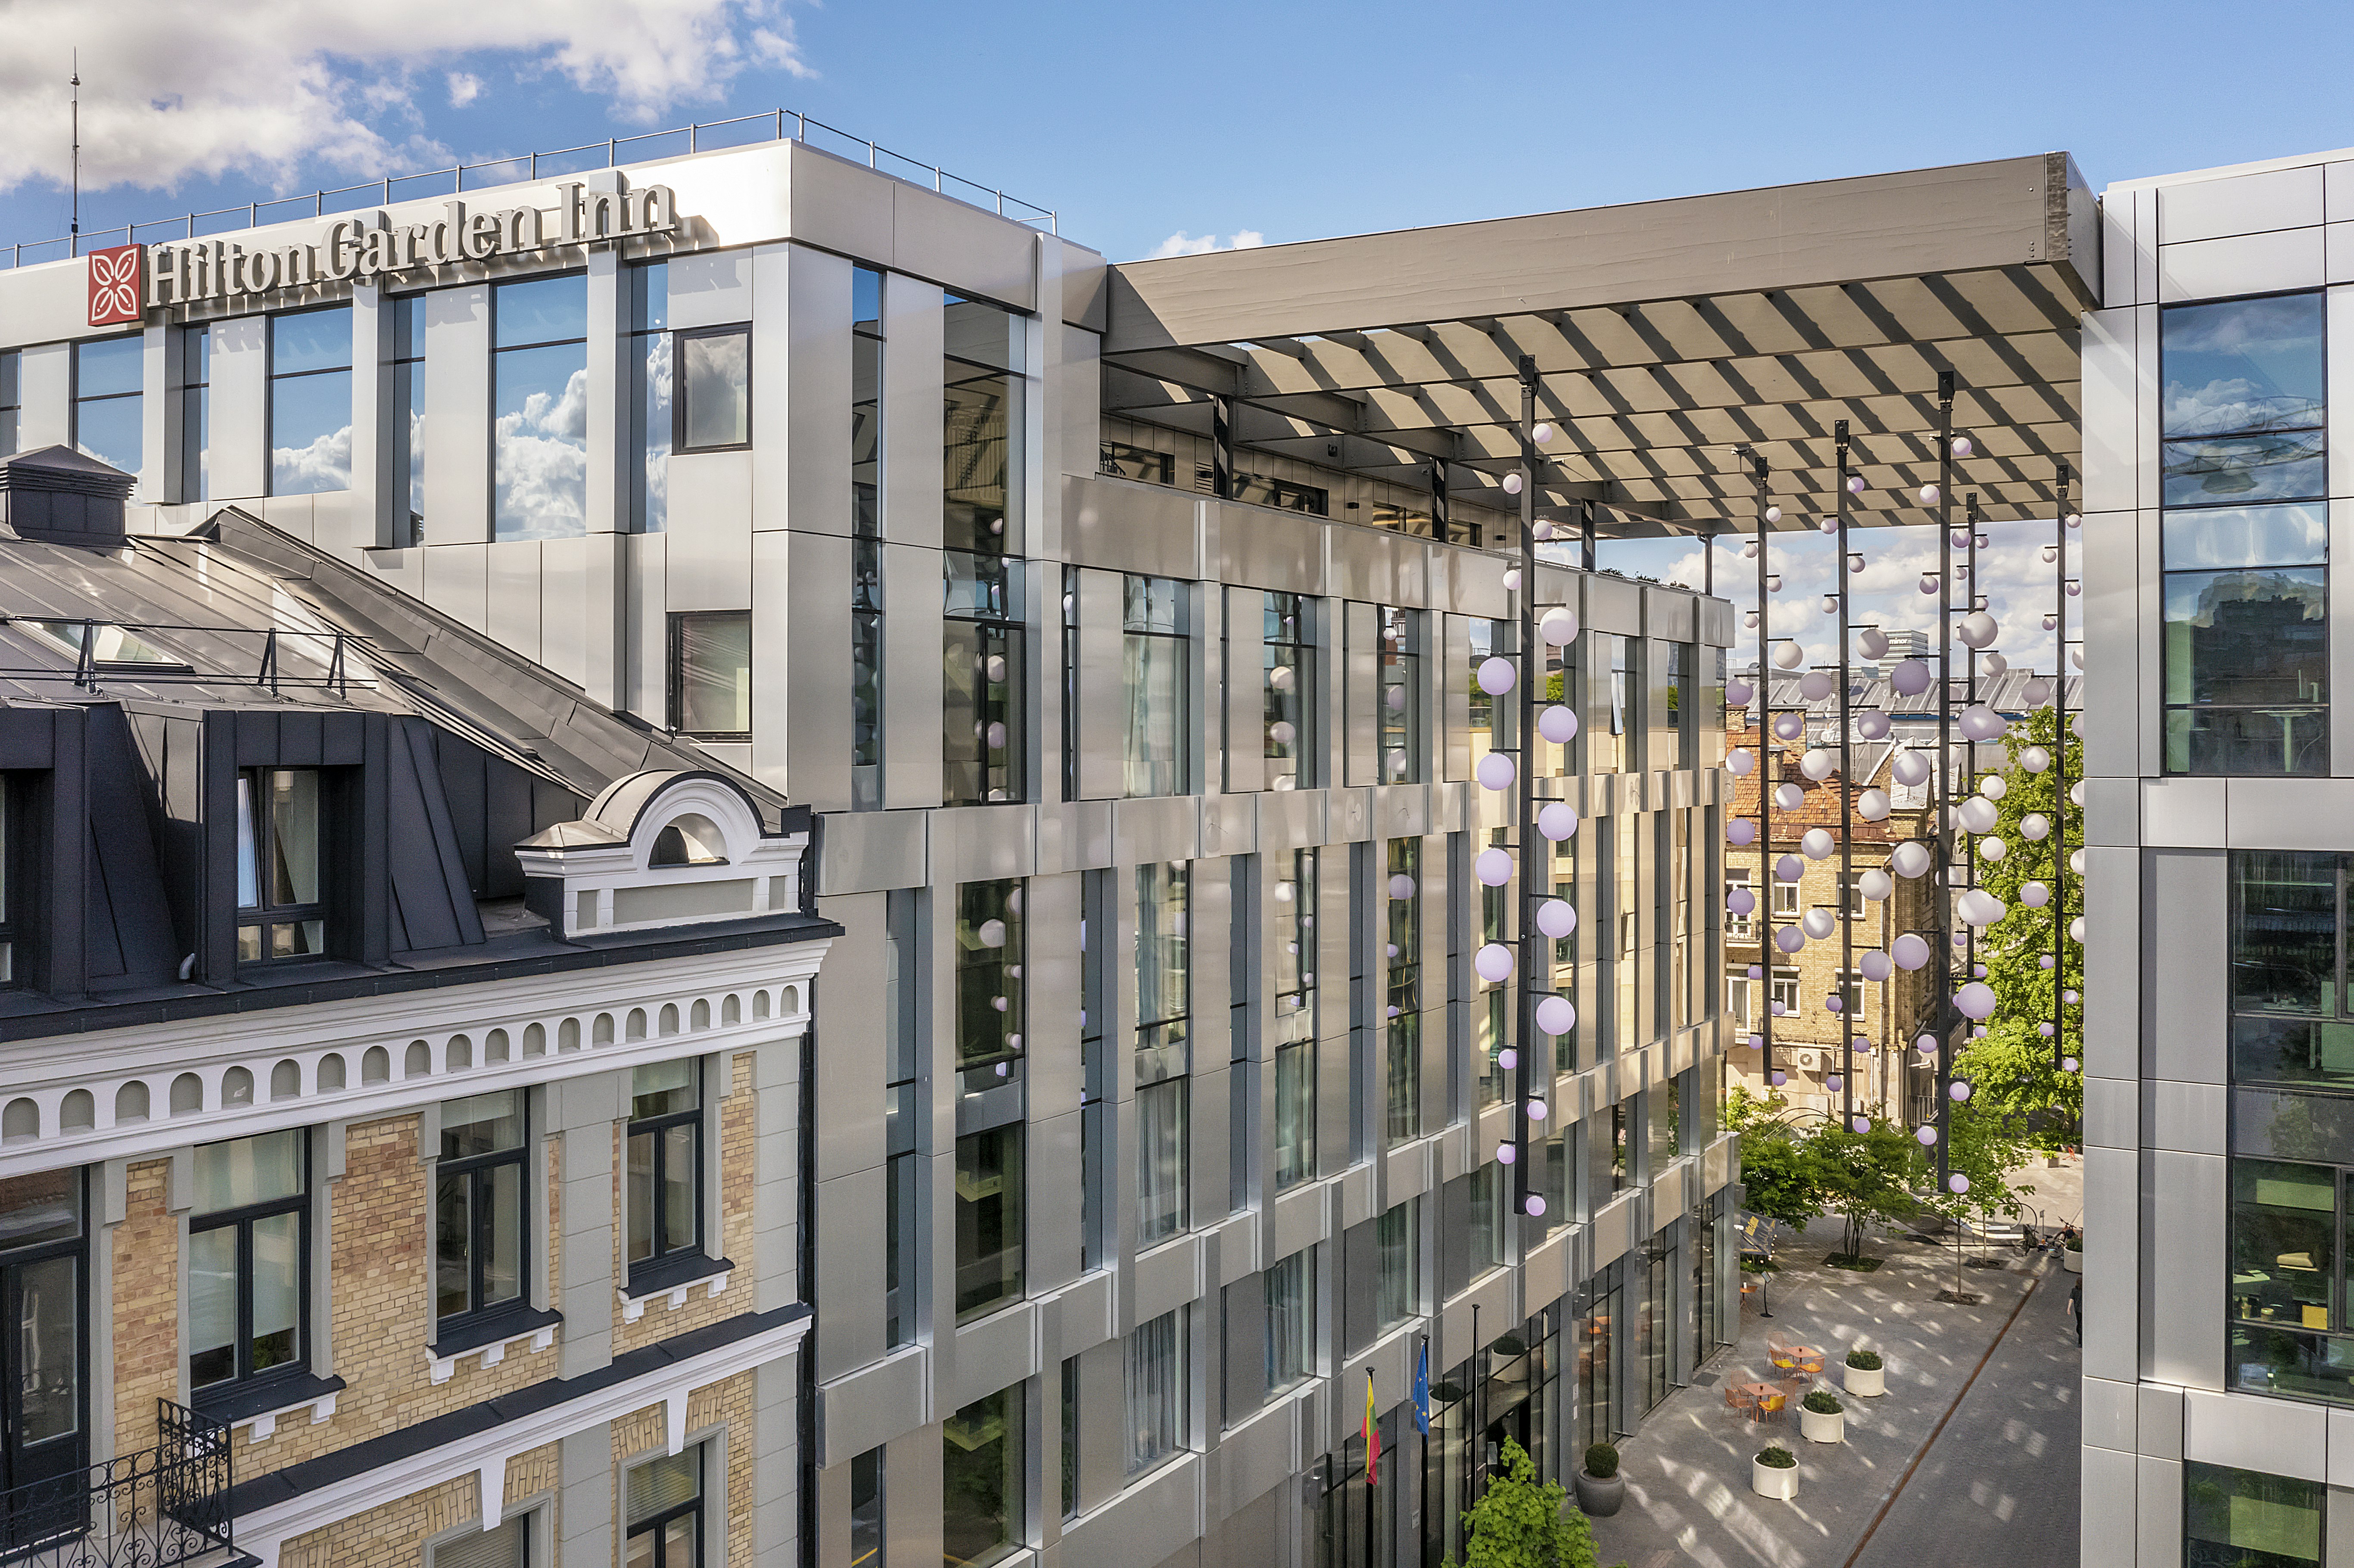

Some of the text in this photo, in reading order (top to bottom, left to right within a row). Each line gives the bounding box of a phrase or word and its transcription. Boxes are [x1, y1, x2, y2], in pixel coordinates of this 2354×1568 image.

[146, 181, 682, 308] Hilton Garden Inn
